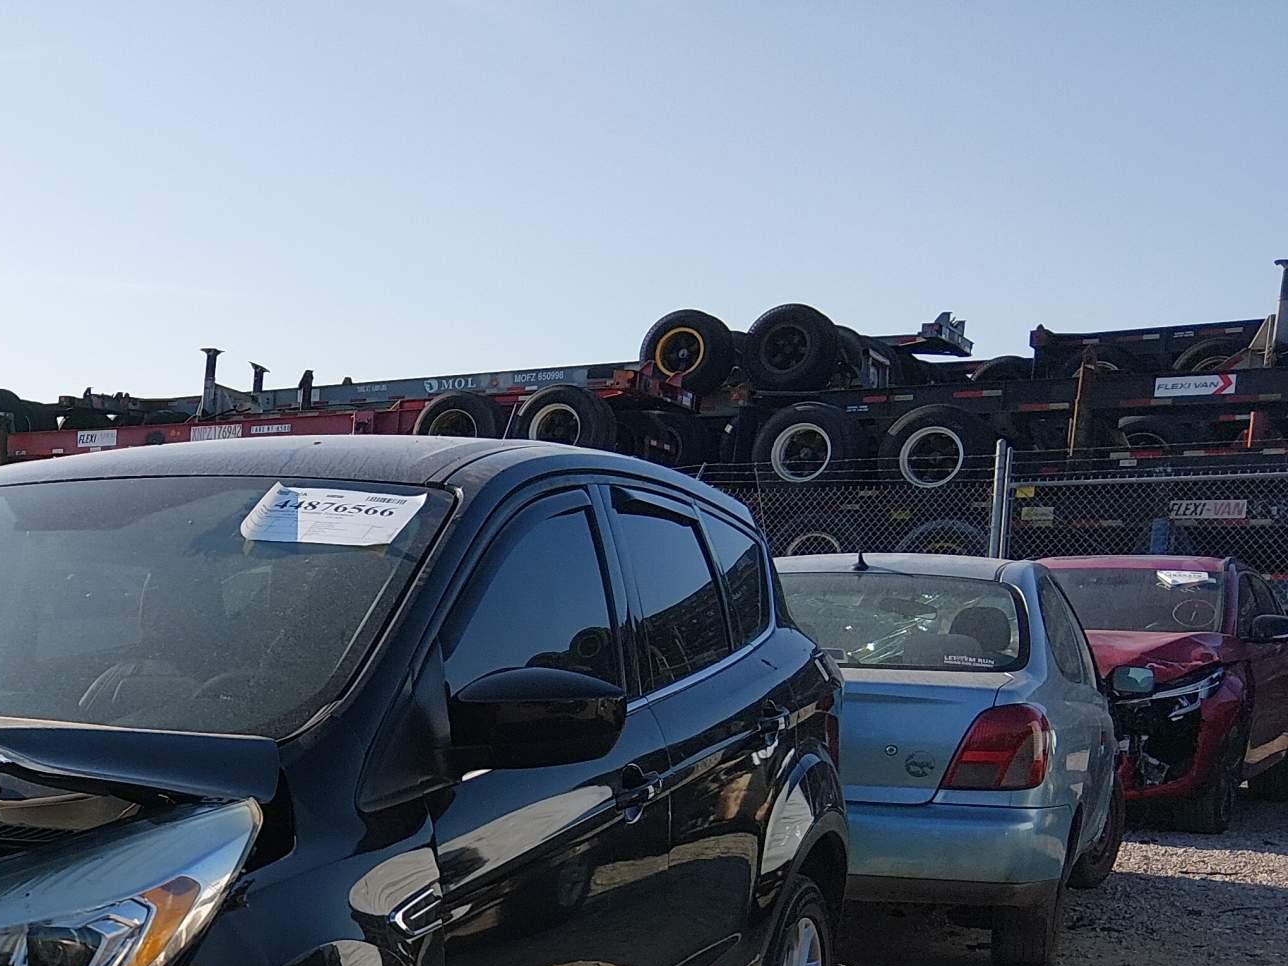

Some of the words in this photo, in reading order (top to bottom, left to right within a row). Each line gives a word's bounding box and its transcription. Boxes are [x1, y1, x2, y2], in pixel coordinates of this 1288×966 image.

[514, 372, 536, 383] MOFZ
[440, 377, 476, 391] MOL
[1156, 382, 1192, 391] FLEXI
[1194, 380, 1220, 389] VAN
[78, 433, 97, 444] FLEXI
[274, 499, 397, 518] 44876566
